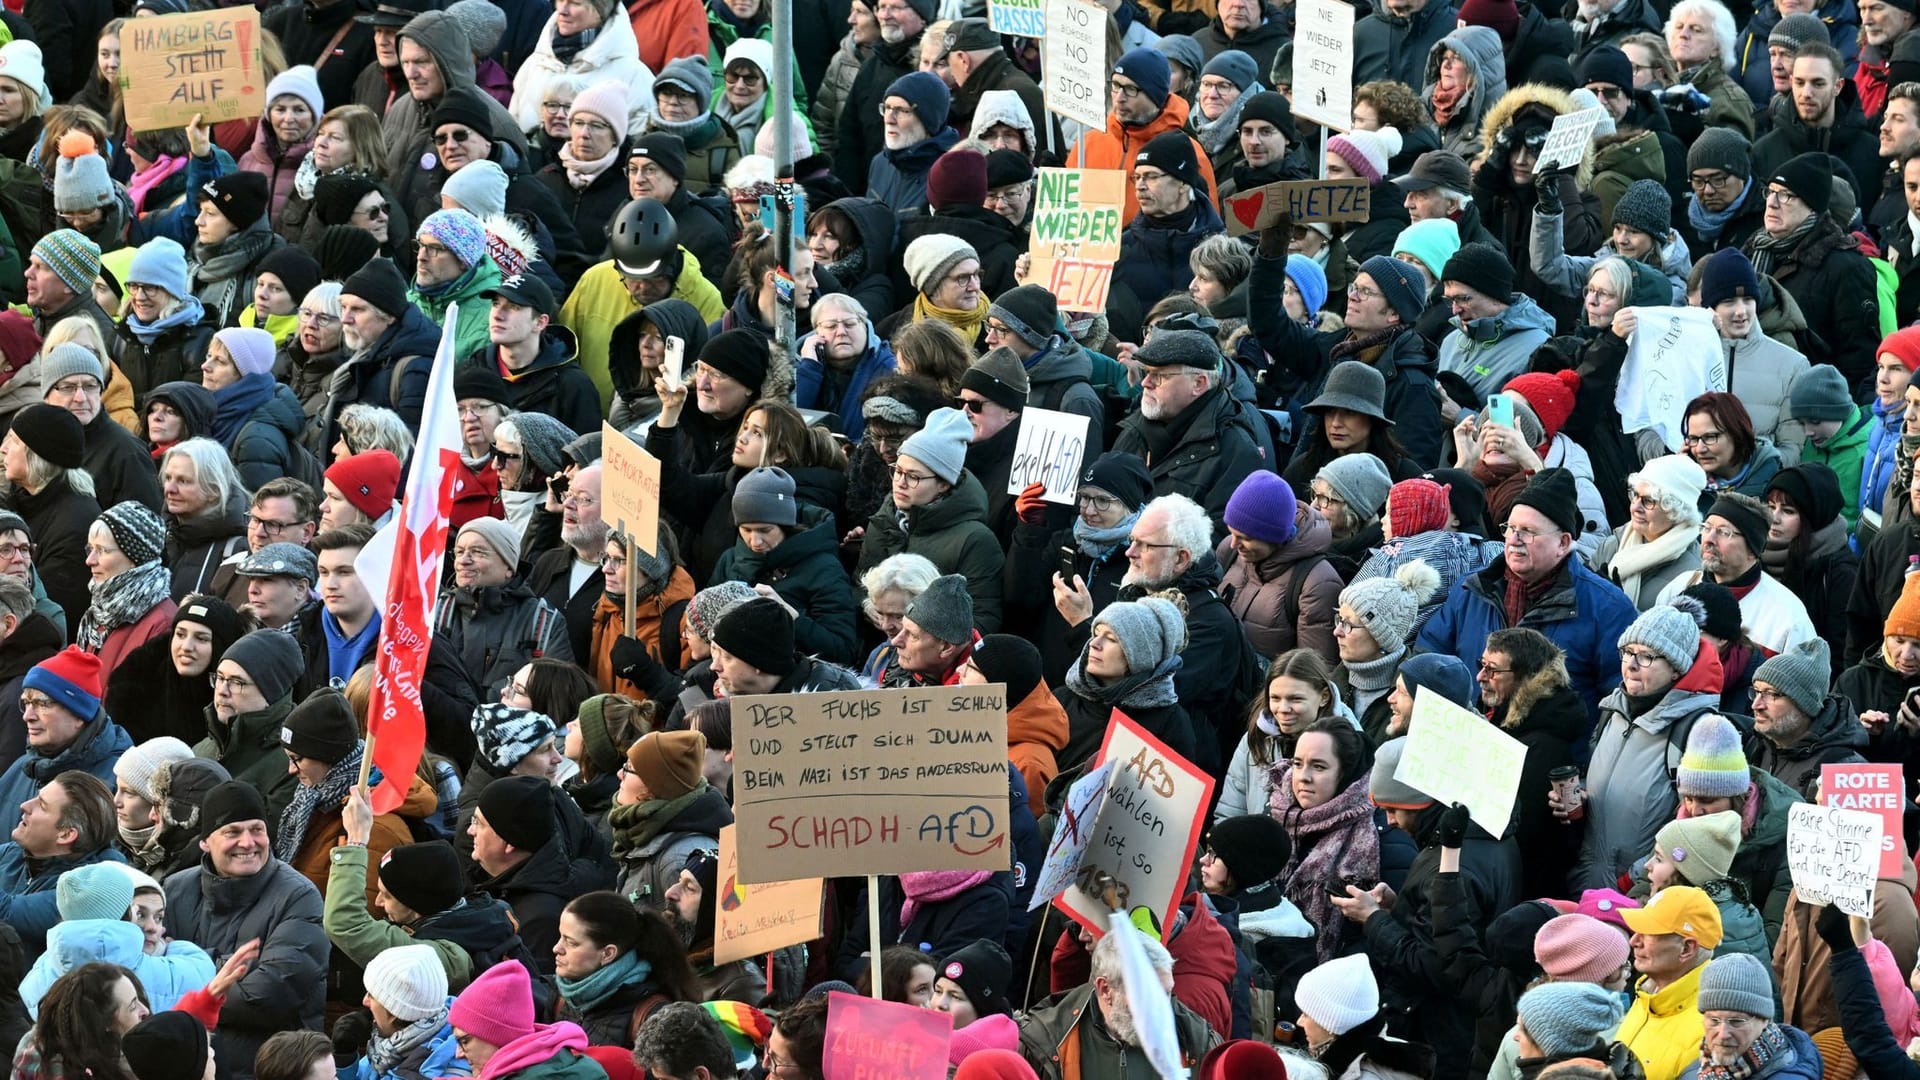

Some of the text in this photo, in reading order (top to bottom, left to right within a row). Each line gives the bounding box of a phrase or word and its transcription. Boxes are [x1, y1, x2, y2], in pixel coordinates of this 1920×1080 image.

[1066, 6, 1088, 26] NO
[1318, 8, 1333, 23] NIE
[134, 20, 233, 52] HAMBURG
[1060, 24, 1092, 45] BORDERS
[1306, 31, 1343, 53] WIEDER
[1065, 43, 1088, 63] NO
[1063, 63, 1090, 80] NATION
[1309, 58, 1337, 76] JETZT
[168, 79, 224, 104] AUF
[1060, 76, 1093, 102] STOP
[1052, 94, 1101, 122] DEPORTATION
[1546, 123, 1595, 150] GEGEN
[1038, 171, 1080, 209] NIE
[1288, 185, 1367, 221] HETZE
[1035, 208, 1119, 244] WIEDER
[1052, 243, 1080, 257] IST
[607, 447, 660, 500] DEMOKRATIE
[746, 703, 797, 728] DER
[822, 699, 881, 720] FUCHS
[948, 696, 1003, 712] SCHLAU
[750, 738, 782, 755] UND
[799, 734, 858, 752] STELLT
[927, 728, 993, 745] DUMM
[877, 766, 909, 780] DAS
[916, 762, 1006, 781] ANDERSRUM
[1125, 746, 1175, 799] AfD
[1835, 773, 1890, 788] ROTE
[1107, 786, 1165, 838] wählen
[1827, 793, 1898, 809] KARTE
[1827, 808, 1872, 840] Stimme
[1104, 826, 1126, 856] ist
[1790, 833, 1806, 856] für
[1810, 836, 1826, 854] die
[1790, 856, 1809, 872] und
[1814, 857, 1832, 877] ihre
